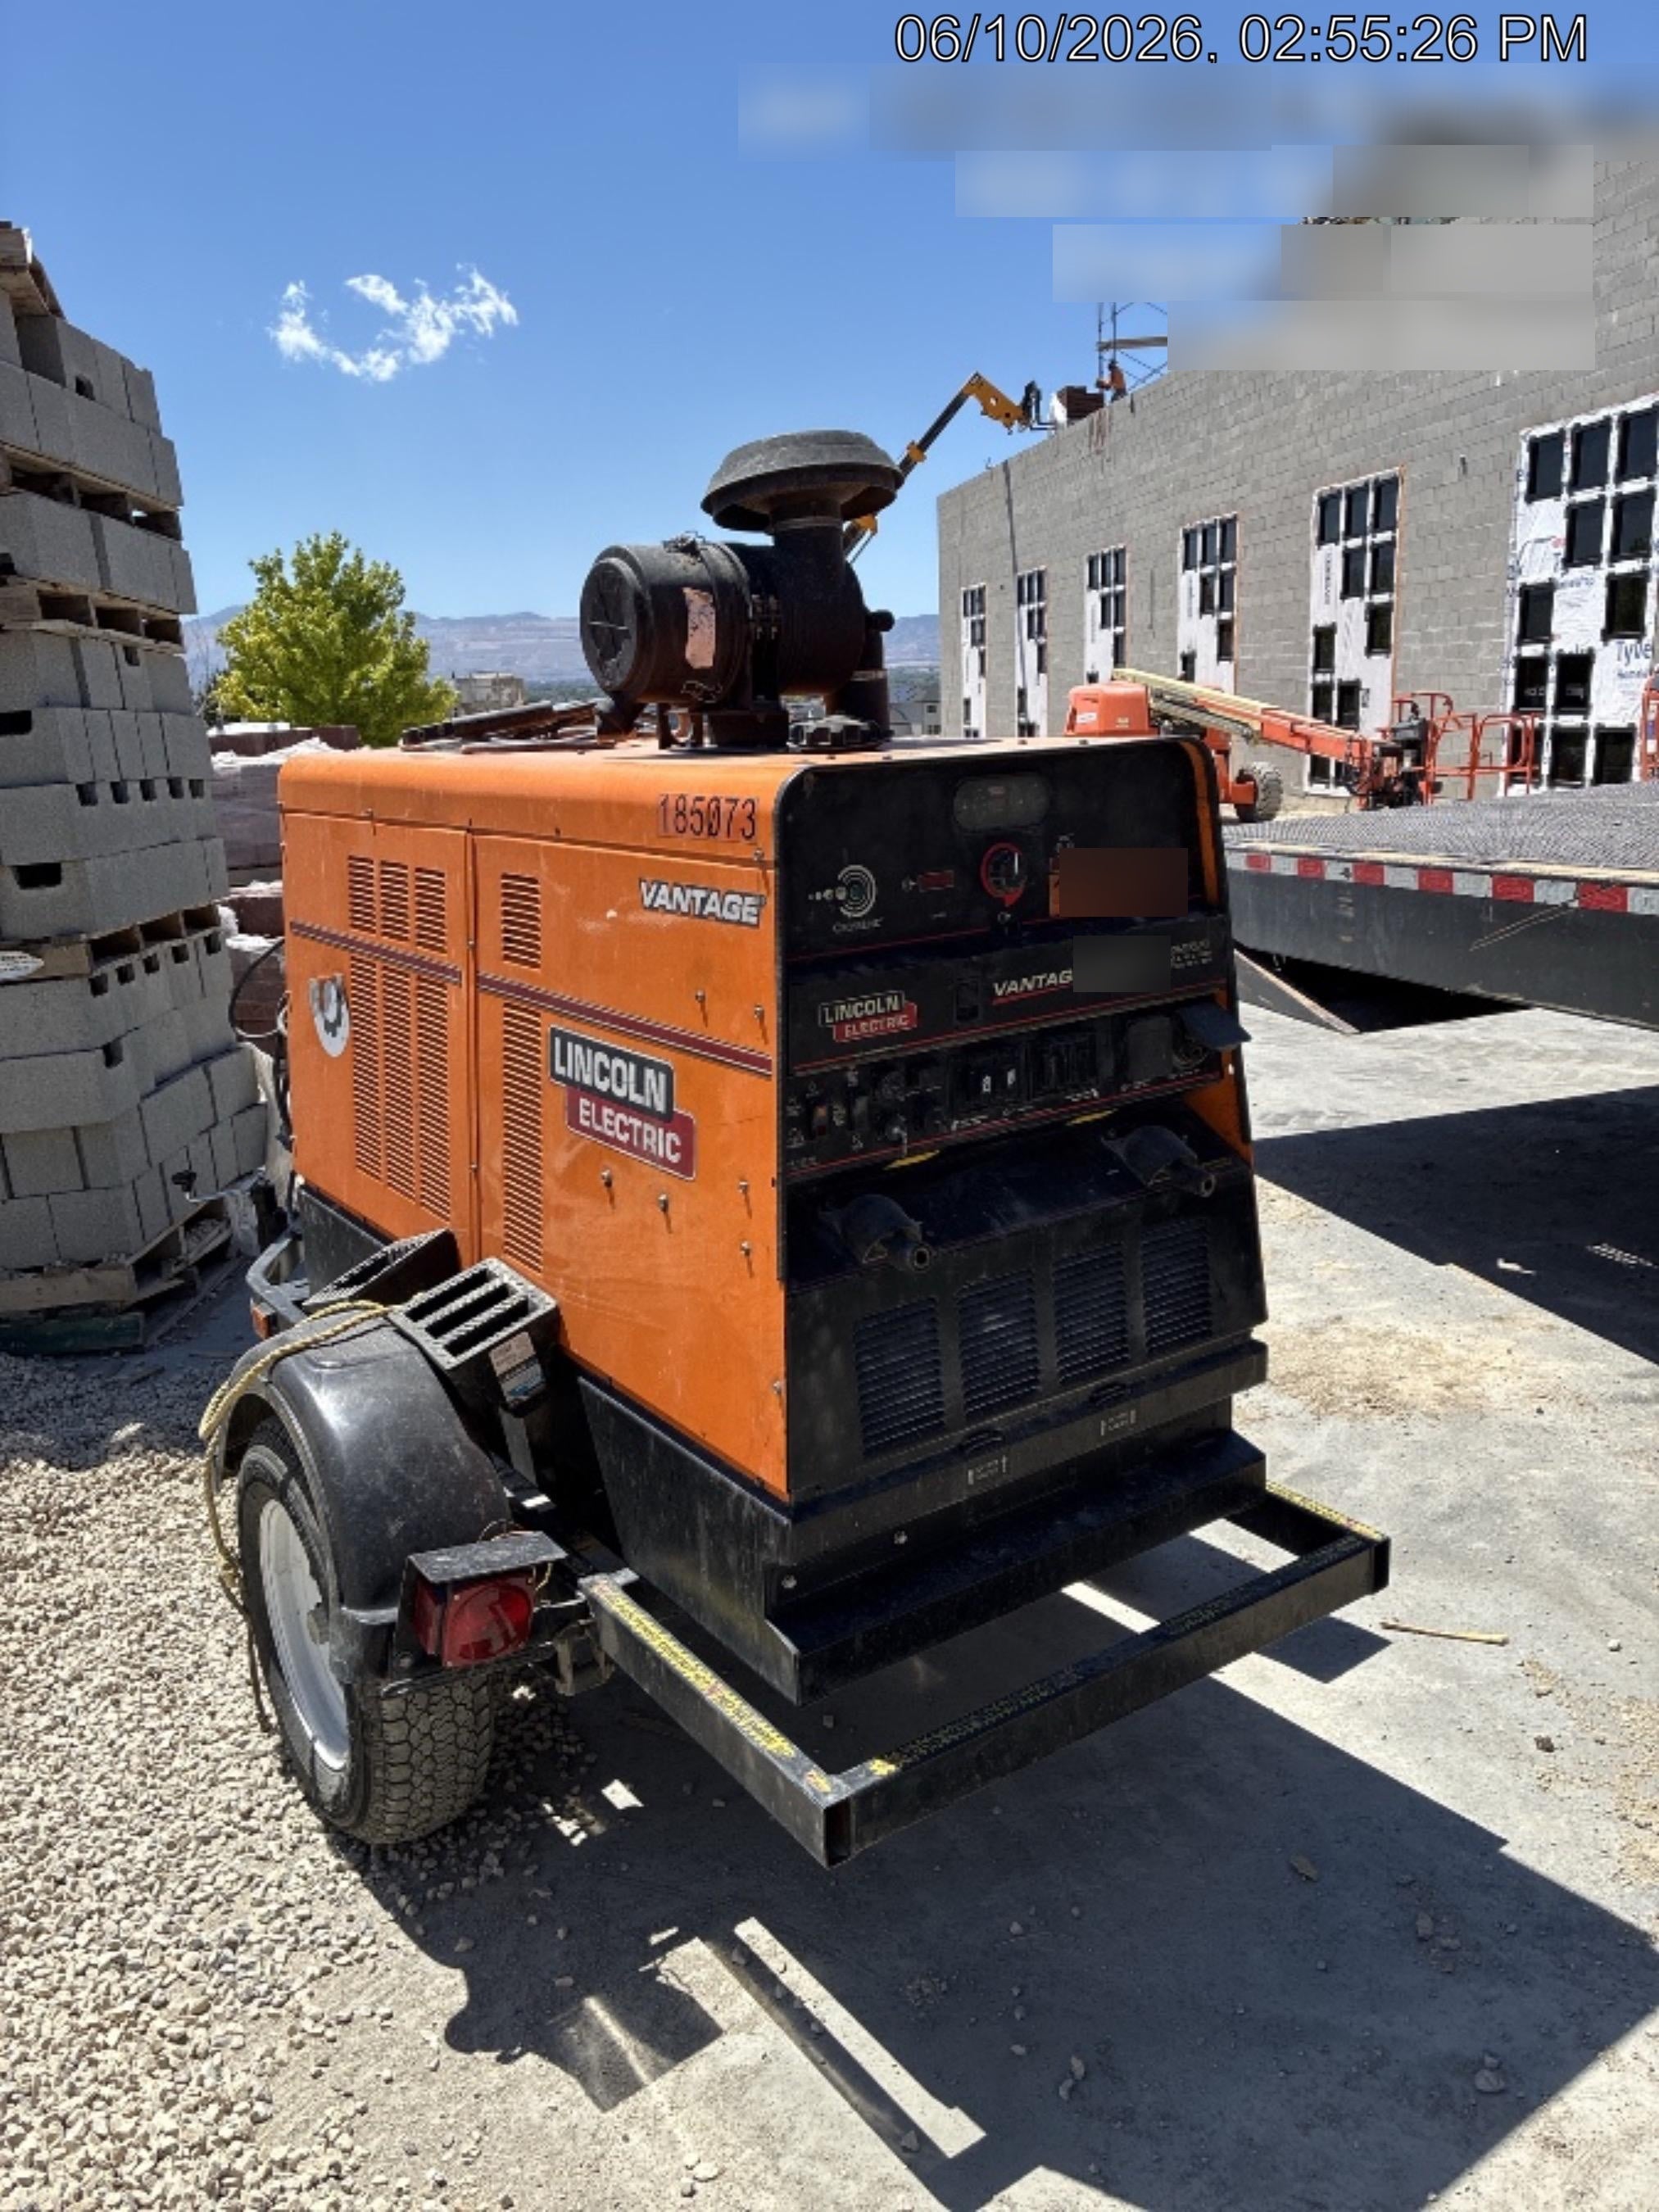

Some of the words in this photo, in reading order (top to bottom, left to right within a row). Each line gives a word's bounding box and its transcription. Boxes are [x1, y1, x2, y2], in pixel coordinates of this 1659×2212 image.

[1616, 639, 1652, 667] Tyve
[660, 794, 756, 840] 185073
[640, 880, 760, 927] VANTAGE
[993, 969, 1072, 996] VANTAG
[823, 995, 900, 1023] LINCOLN
[845, 1014, 910, 1038] ELECTRIC
[554, 1036, 667, 1114] LINCOLN
[578, 1097, 682, 1163] ELECTRIC
